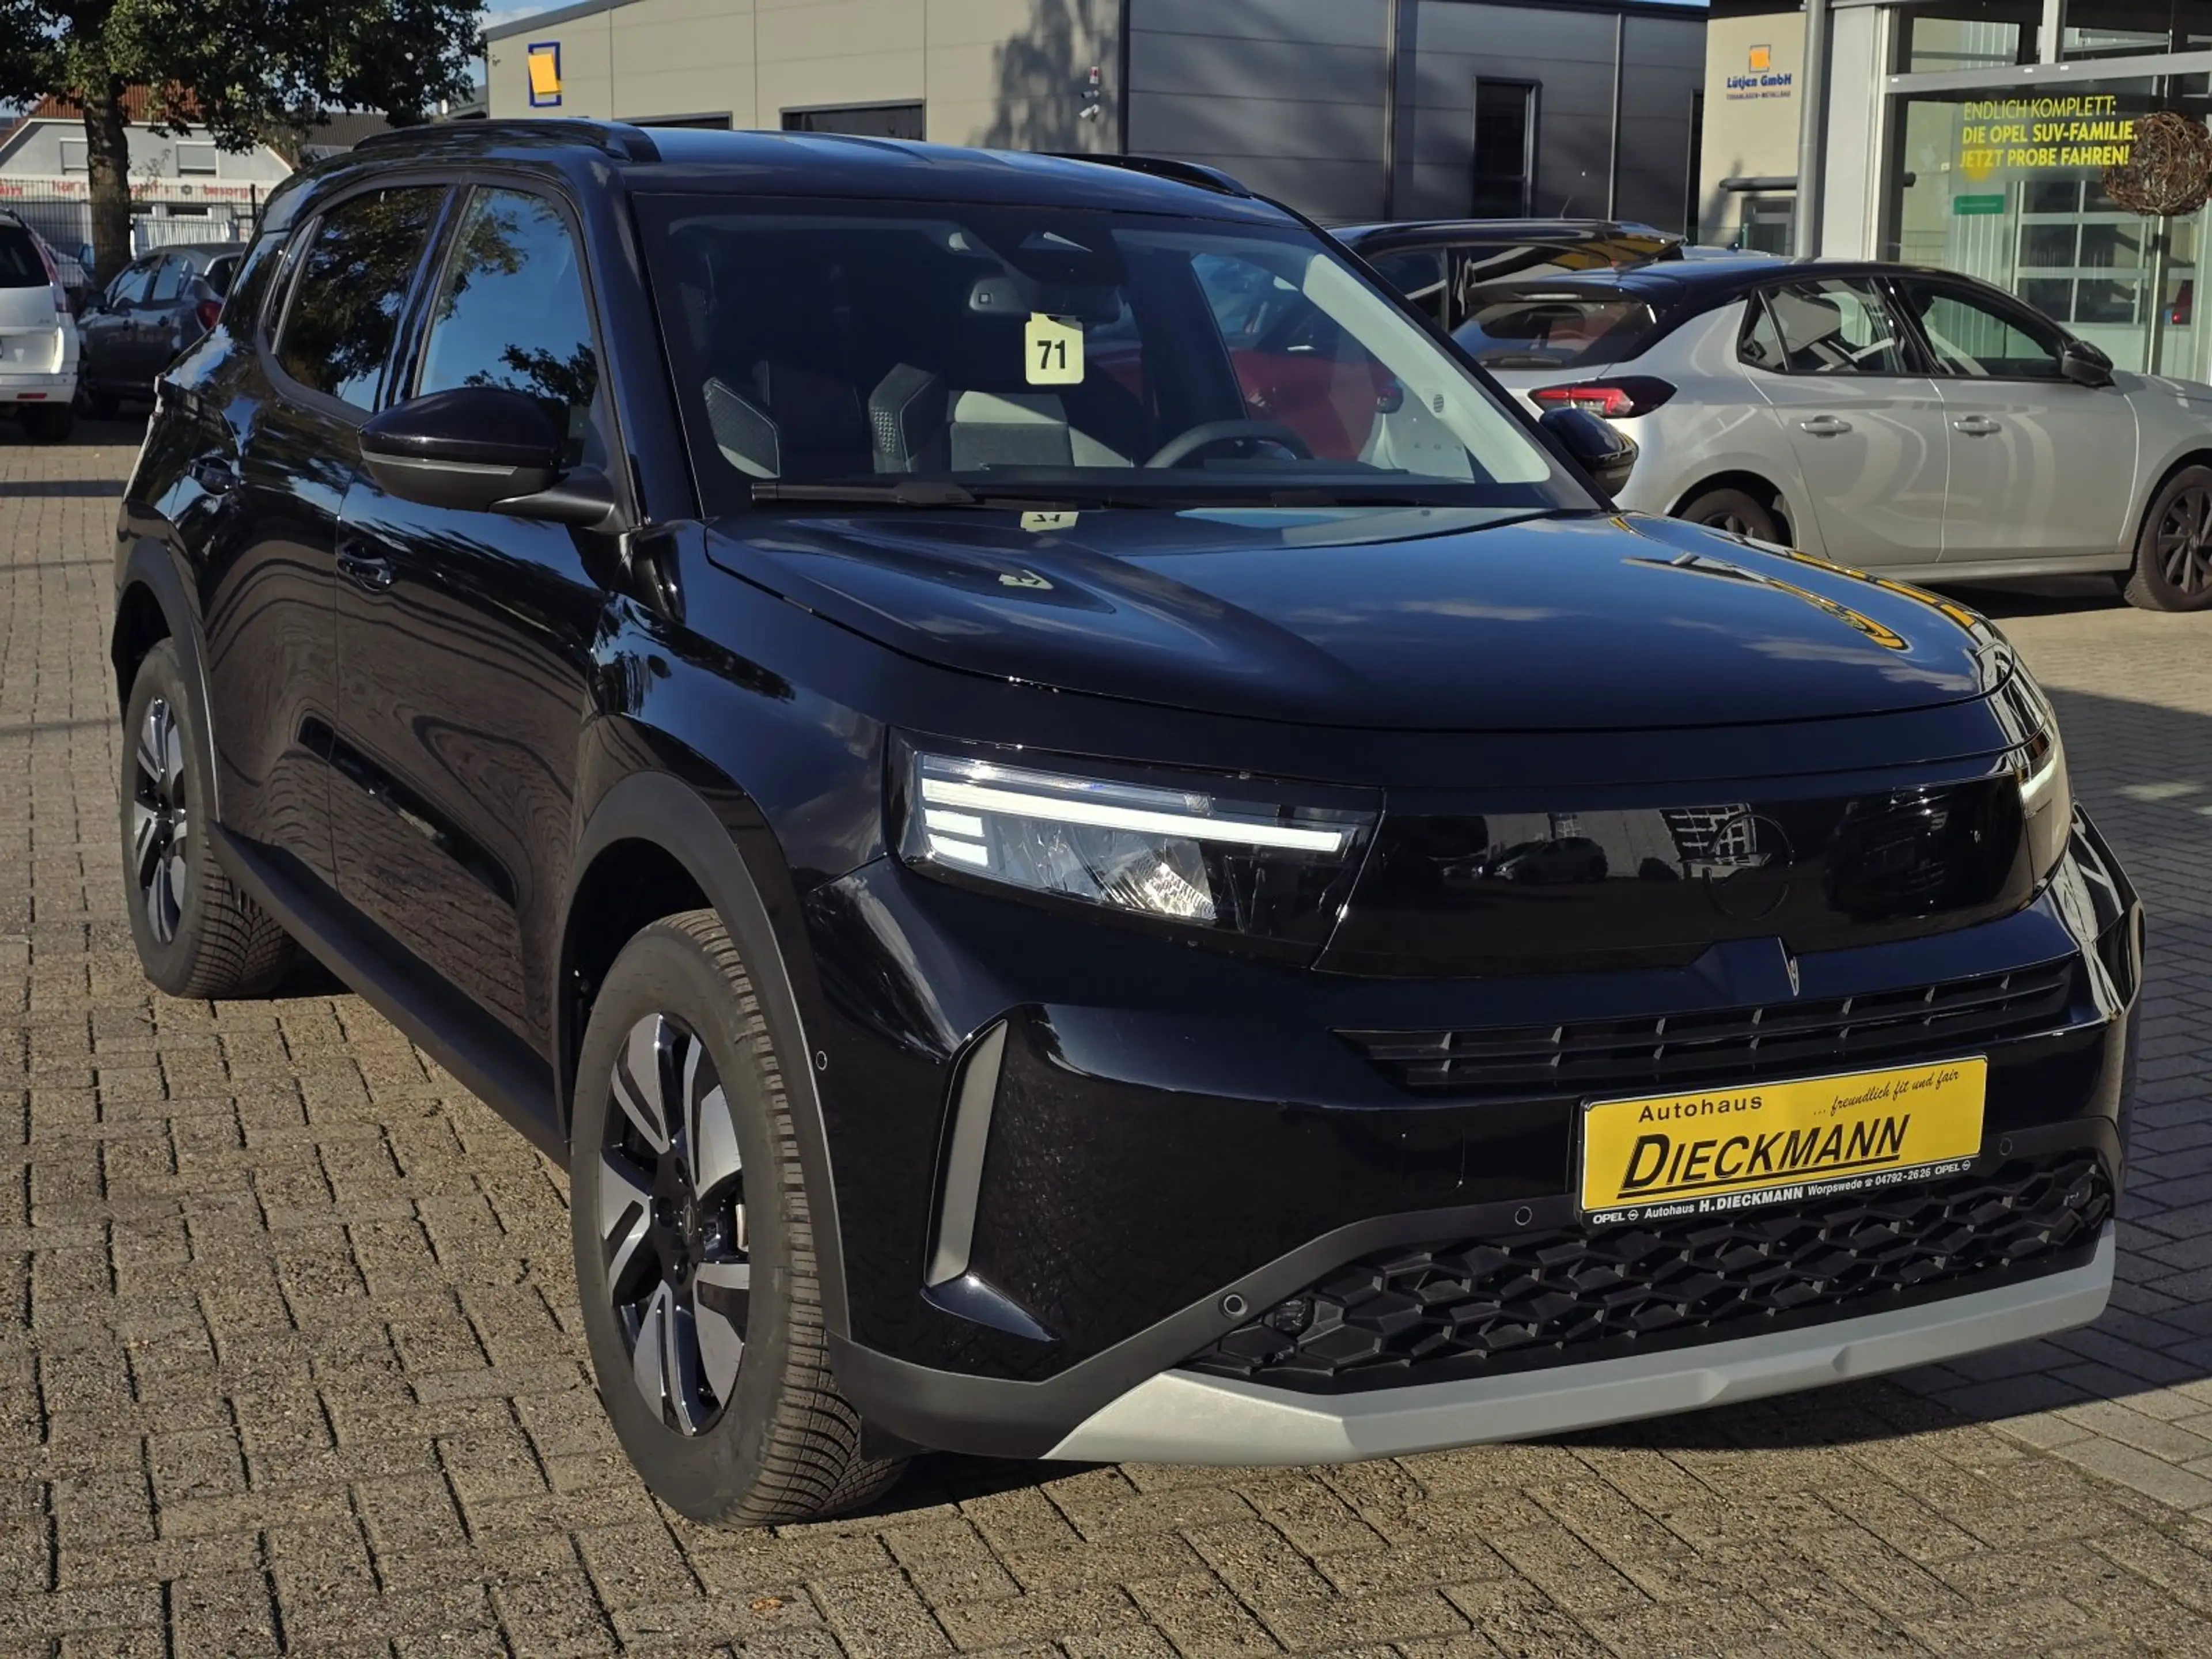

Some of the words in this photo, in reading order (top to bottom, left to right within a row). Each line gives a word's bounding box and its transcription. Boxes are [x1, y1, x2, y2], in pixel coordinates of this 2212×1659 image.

[1726, 75, 1758, 90] Lütjen
[1760, 73, 1791, 86] GmbH
[1964, 100, 2027, 120] ENDLICH
[2031, 95, 2117, 119] KOMPLETT:
[1962, 125, 1987, 145] DIE
[1990, 123, 2028, 143] OPEL
[1959, 149, 2005, 168] JETZT
[2007, 147, 2058, 166] PROBE
[2061, 144, 2130, 166] FAHREN!
[1037, 339, 1066, 370] 71
[1830, 1081, 1889, 1116] freundlich
[1892, 1080, 1910, 1101] fit
[1912, 1072, 1934, 1090] und
[1936, 1069, 1960, 1090] fair
[1638, 1096, 1763, 1123] Autohaus
[1620, 1113, 1911, 1191] DIECKMANN
[1593, 1212, 1625, 1225] OPEL
[1644, 1203, 1695, 1219] Autohaus
[1808, 1179, 1862, 1196] Worpswede
[1874, 1168, 1931, 1186] 04792-2626
[1935, 1162, 1960, 1175] OPEL
